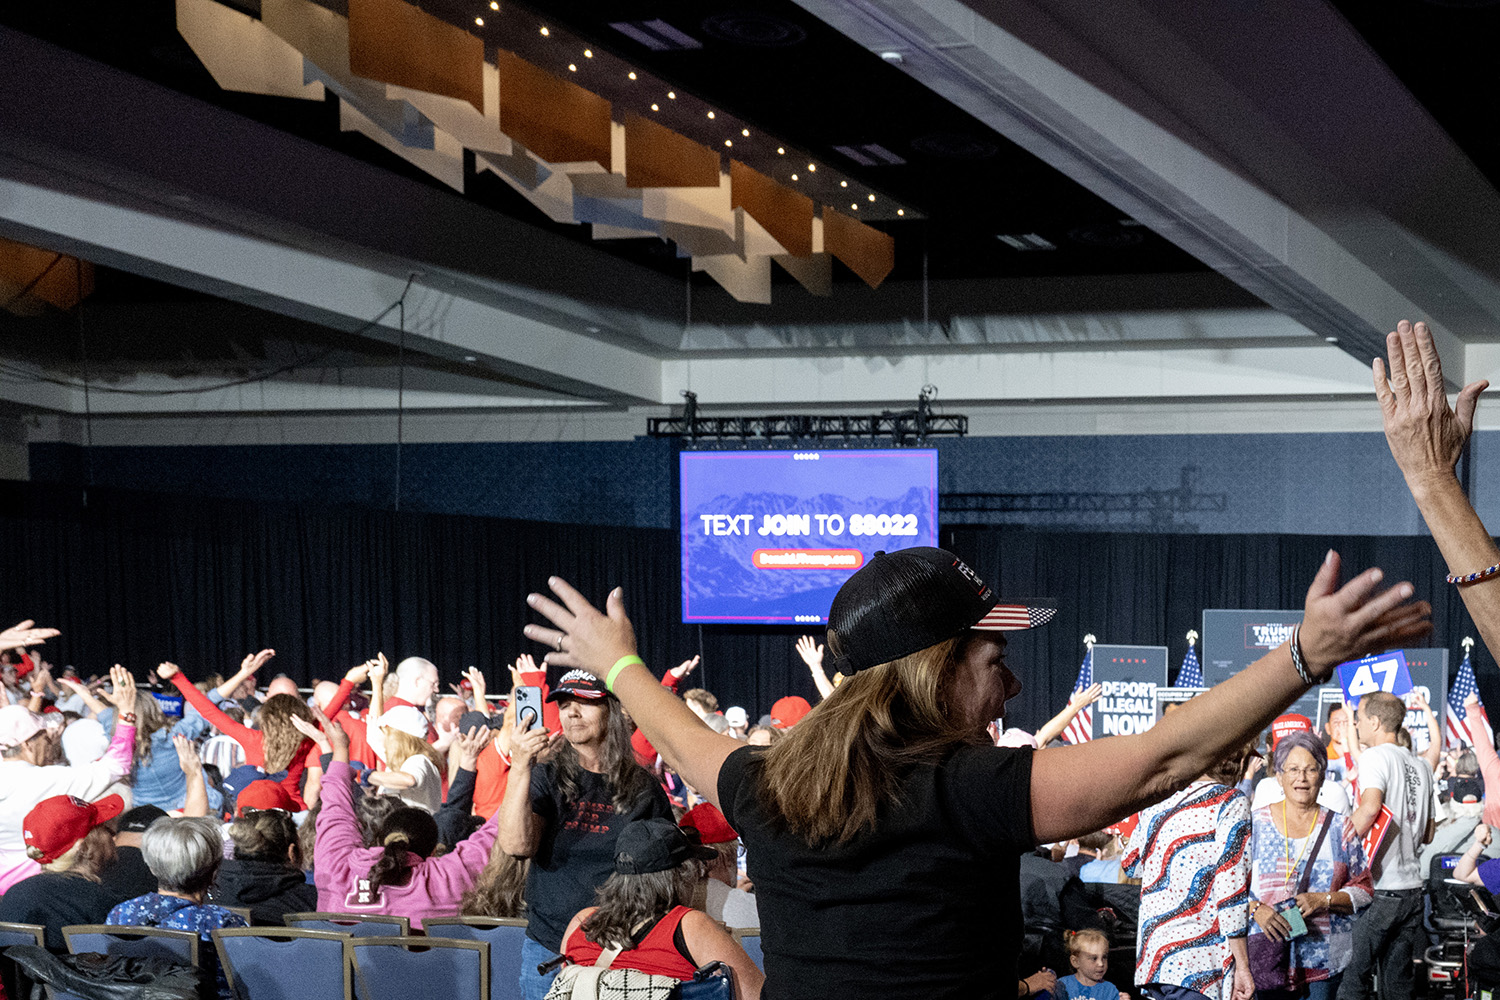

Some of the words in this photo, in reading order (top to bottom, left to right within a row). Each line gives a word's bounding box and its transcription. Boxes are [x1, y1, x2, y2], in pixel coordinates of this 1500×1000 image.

[700, 514, 754, 536] TEXT
[757, 514, 810, 536] JOIN
[815, 514, 845, 536] TO
[849, 513, 918, 536] 88022
[1348, 658, 1399, 697] 47
[1101, 681, 1157, 697] DEPORT
[1102, 714, 1157, 736] NOW
